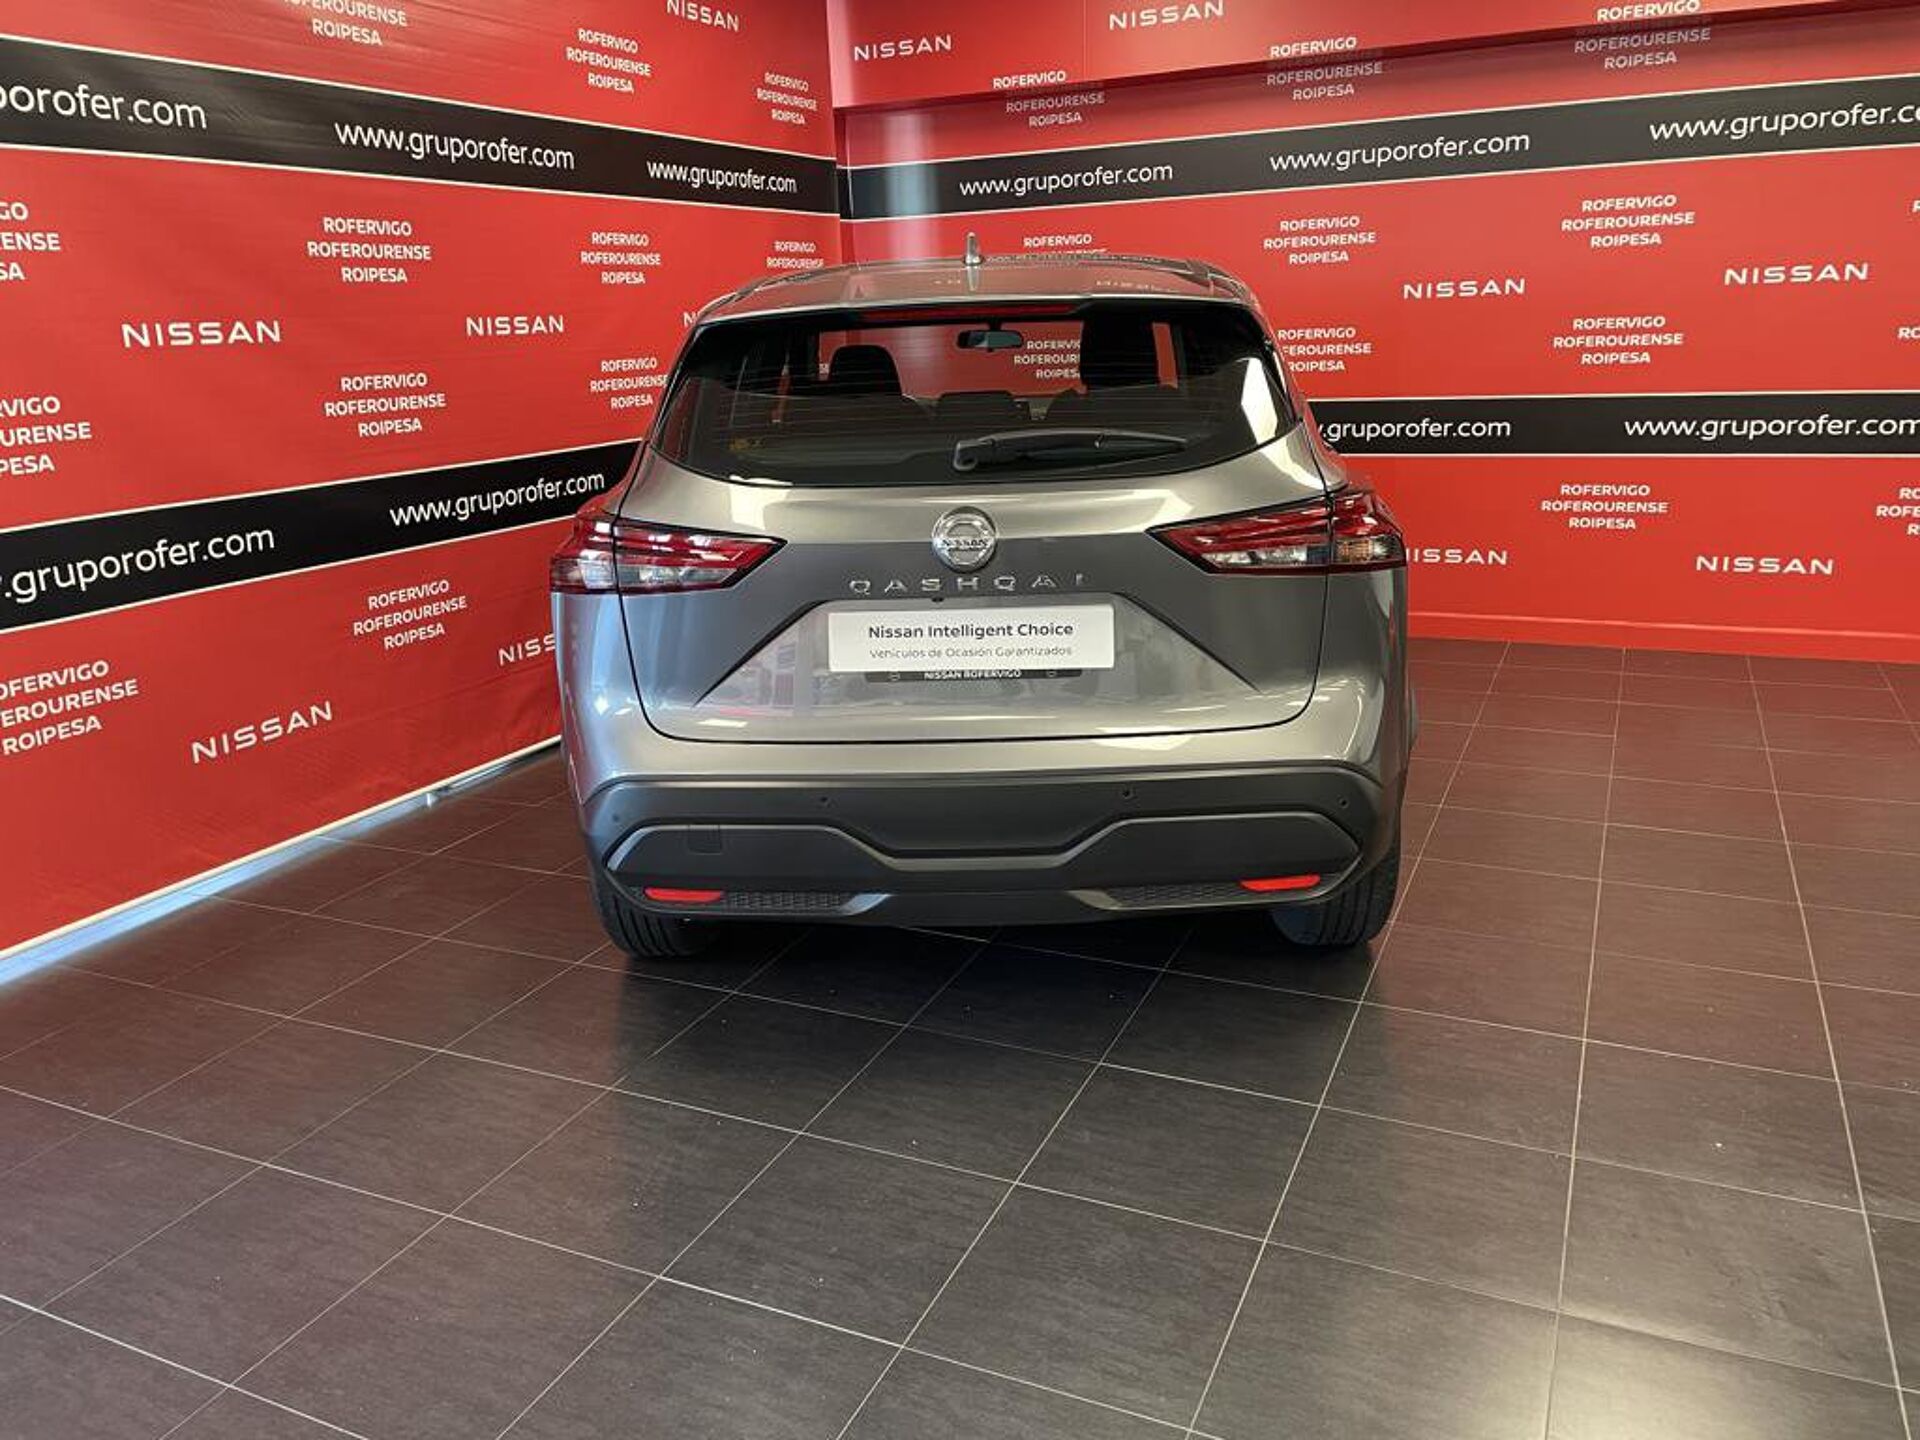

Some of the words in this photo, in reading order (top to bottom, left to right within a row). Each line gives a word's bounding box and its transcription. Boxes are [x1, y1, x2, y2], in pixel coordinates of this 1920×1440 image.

[666, 0, 738, 31] NISSAN
[1109, 0, 1224, 30] NISSAN
[1596, 0, 1701, 22] ROFERVIGO
[311, 18, 383, 46] ROIPESA
[578, 28, 639, 54] ROFERVIGO
[1574, 28, 1712, 54] ROFEROURENSE
[853, 34, 952, 62] NISSAN
[1269, 36, 1357, 59] ROFERVIGO
[566, 46, 652, 77] ROFEROURENSE
[1604, 50, 1678, 69] ROIPESA
[587, 71, 635, 93] ROIPESA
[764, 72, 810, 93] ROFERVIGO
[993, 70, 1067, 89] ROFERVIGO
[1266, 61, 1383, 86] ROFEROURENSE
[756, 87, 818, 111] ROFEROURENSE
[1006, 92, 1105, 113] ROFEROURENSE
[1292, 83, 1355, 101] ROIPESA
[771, 108, 806, 125] ROIPESA
[1028, 112, 1083, 127] ROIPESA
[1649, 102, 1920, 140] www.gruporofer.c
[334, 122, 576, 170] www.gruporofer.com
[1269, 133, 1531, 171] www.gruporofer.com
[646, 161, 797, 192] www.gruporofer.com
[959, 165, 1173, 197] www.gruporofer.com
[1582, 194, 1677, 212] ROFERVIGO
[323, 216, 412, 237] ROFERVIGO
[1280, 215, 1360, 232] ROFERVIGO
[1561, 211, 1695, 231] ROFEROURENSE
[591, 231, 649, 247] ROFERVIGO
[1023, 233, 1093, 248] ROFERVIGO
[1263, 232, 1376, 249] ROFEROURENSE
[1590, 232, 1662, 248] ROIPESA
[307, 241, 431, 260] ROFEROURENSE
[580, 251, 661, 266] ROFEROURENSE
[1289, 250, 1349, 265] ROIPESA
[341, 267, 408, 283] ROIPESA
[601, 271, 646, 285] ROIPESA
[1724, 263, 1868, 285] NISSAN
[1403, 278, 1525, 299] NISSAN
[466, 315, 564, 336] NISSAN
[1572, 315, 1666, 330] ROFERVIGO
[121, 320, 281, 348] NISSAN
[1277, 327, 1356, 341] ROFERVIGO
[1553, 333, 1684, 348] ROFEROURENSE
[600, 357, 658, 373] ROFERVIGO
[1013, 353, 1080, 365] ROFEROUR
[1581, 351, 1651, 365] ROIPESA
[340, 372, 428, 392] ROFERVIGO
[590, 373, 669, 393] ROFEROURENSE
[324, 393, 446, 417] ROFEROURENSE
[610, 394, 654, 409] ROIPESA
[358, 417, 423, 437] ROIPESA
[1318, 417, 1511, 442] .gruporofer.com
[1624, 413, 1920, 441] www.gruporofer.com
[389, 473, 605, 527] www.gruporofer.com
[1560, 484, 1651, 497] ROFERVIGO
[1541, 500, 1669, 513] ROFEROURENSE
[1569, 517, 1636, 530] ROIPESA
[0, 528, 275, 603] .gruporofer.com
[1696, 555, 1833, 575] NISSAN
[849, 572, 1083, 595] QASHQAI
[368, 579, 450, 610] ROFERVIGO
[353, 596, 467, 636] ROFEROURENSE
[384, 622, 445, 650] ROIPESA
[868, 624, 924, 639] Nissan
[927, 623, 1014, 640] Intelligent
[1017, 622, 1074, 637] Choice
[923, 669, 962, 680] NISSAN
[0, 679, 139, 729] EROURENSE
[2, 715, 102, 756] ROIPESA
[191, 701, 332, 764] NISSAN
